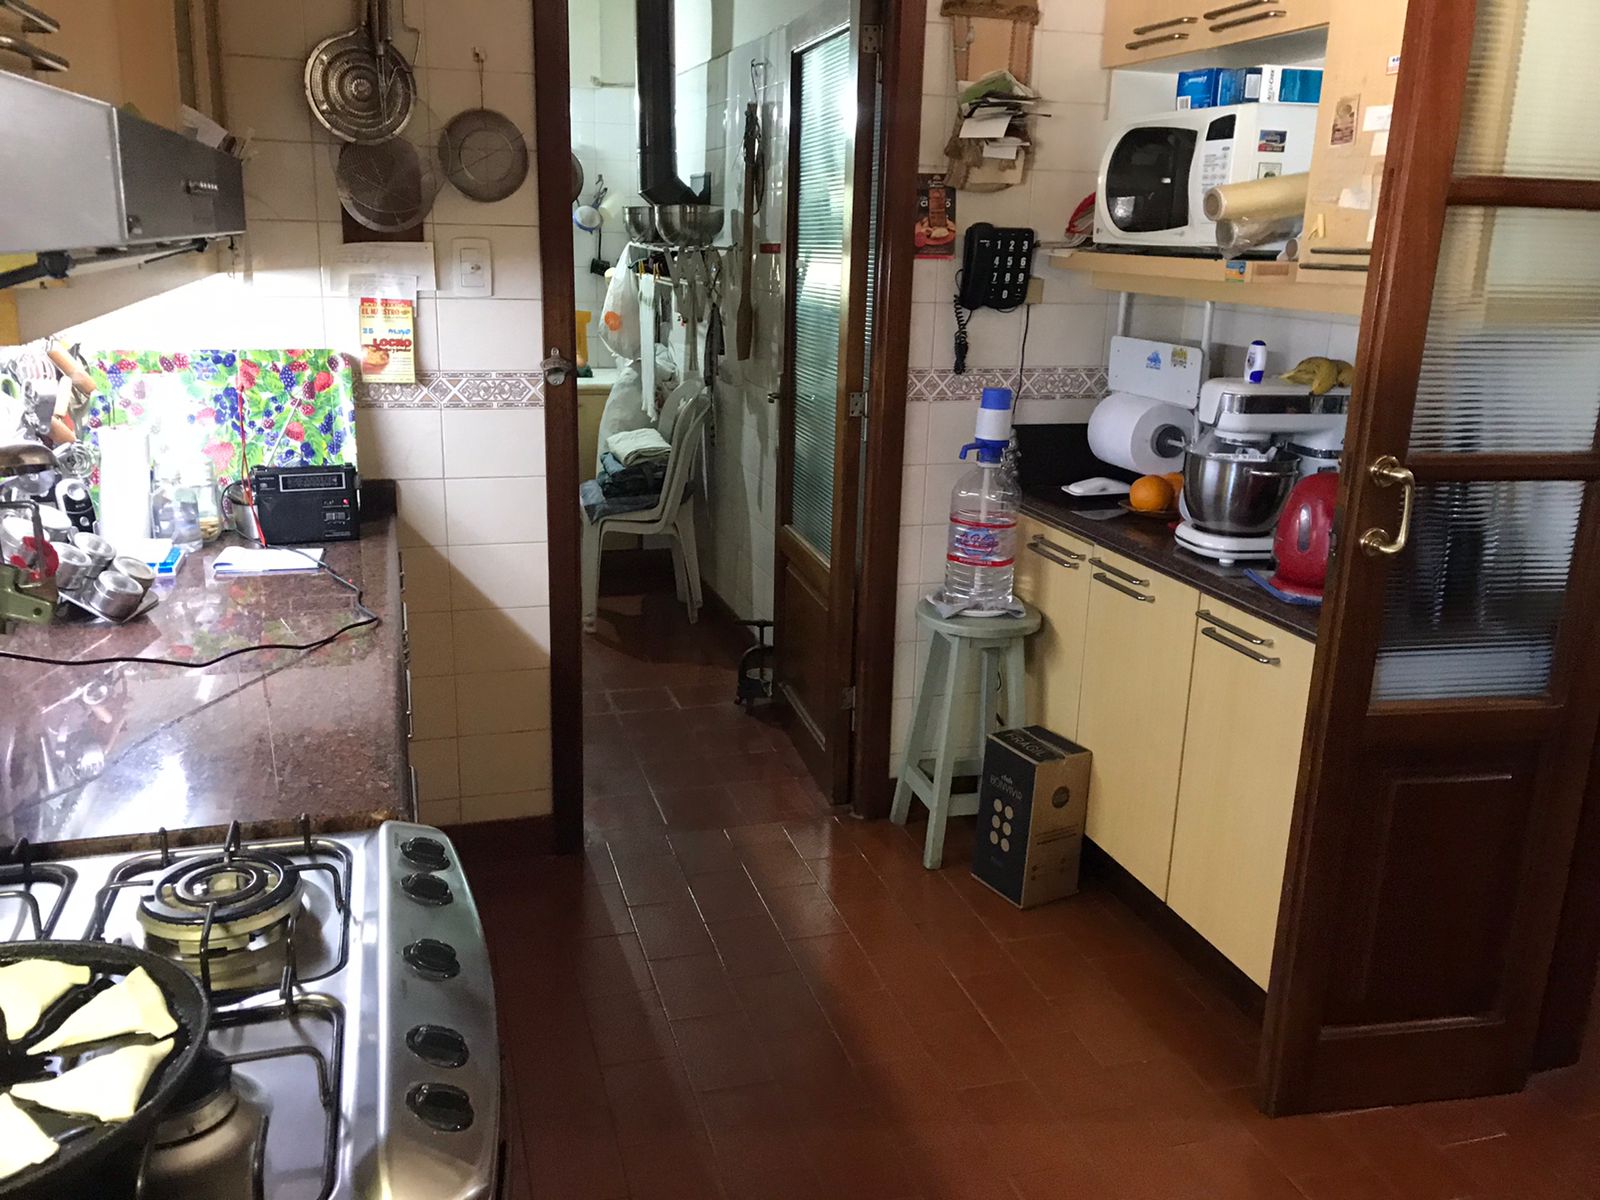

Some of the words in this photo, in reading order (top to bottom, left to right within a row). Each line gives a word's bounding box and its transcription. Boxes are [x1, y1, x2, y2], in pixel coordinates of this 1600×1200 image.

[997, 240, 1002, 249] 1
[1009, 240, 1015, 250] 2
[1022, 240, 1029, 250] 3
[994, 256, 1000, 265] 4
[1007, 256, 1013, 266] 5
[1020, 257, 1027, 266] 6
[992, 272, 998, 282] 7
[1004, 272, 1011, 282] 8
[1018, 273, 1024, 282] 9
[1002, 289, 1008, 299] 0
